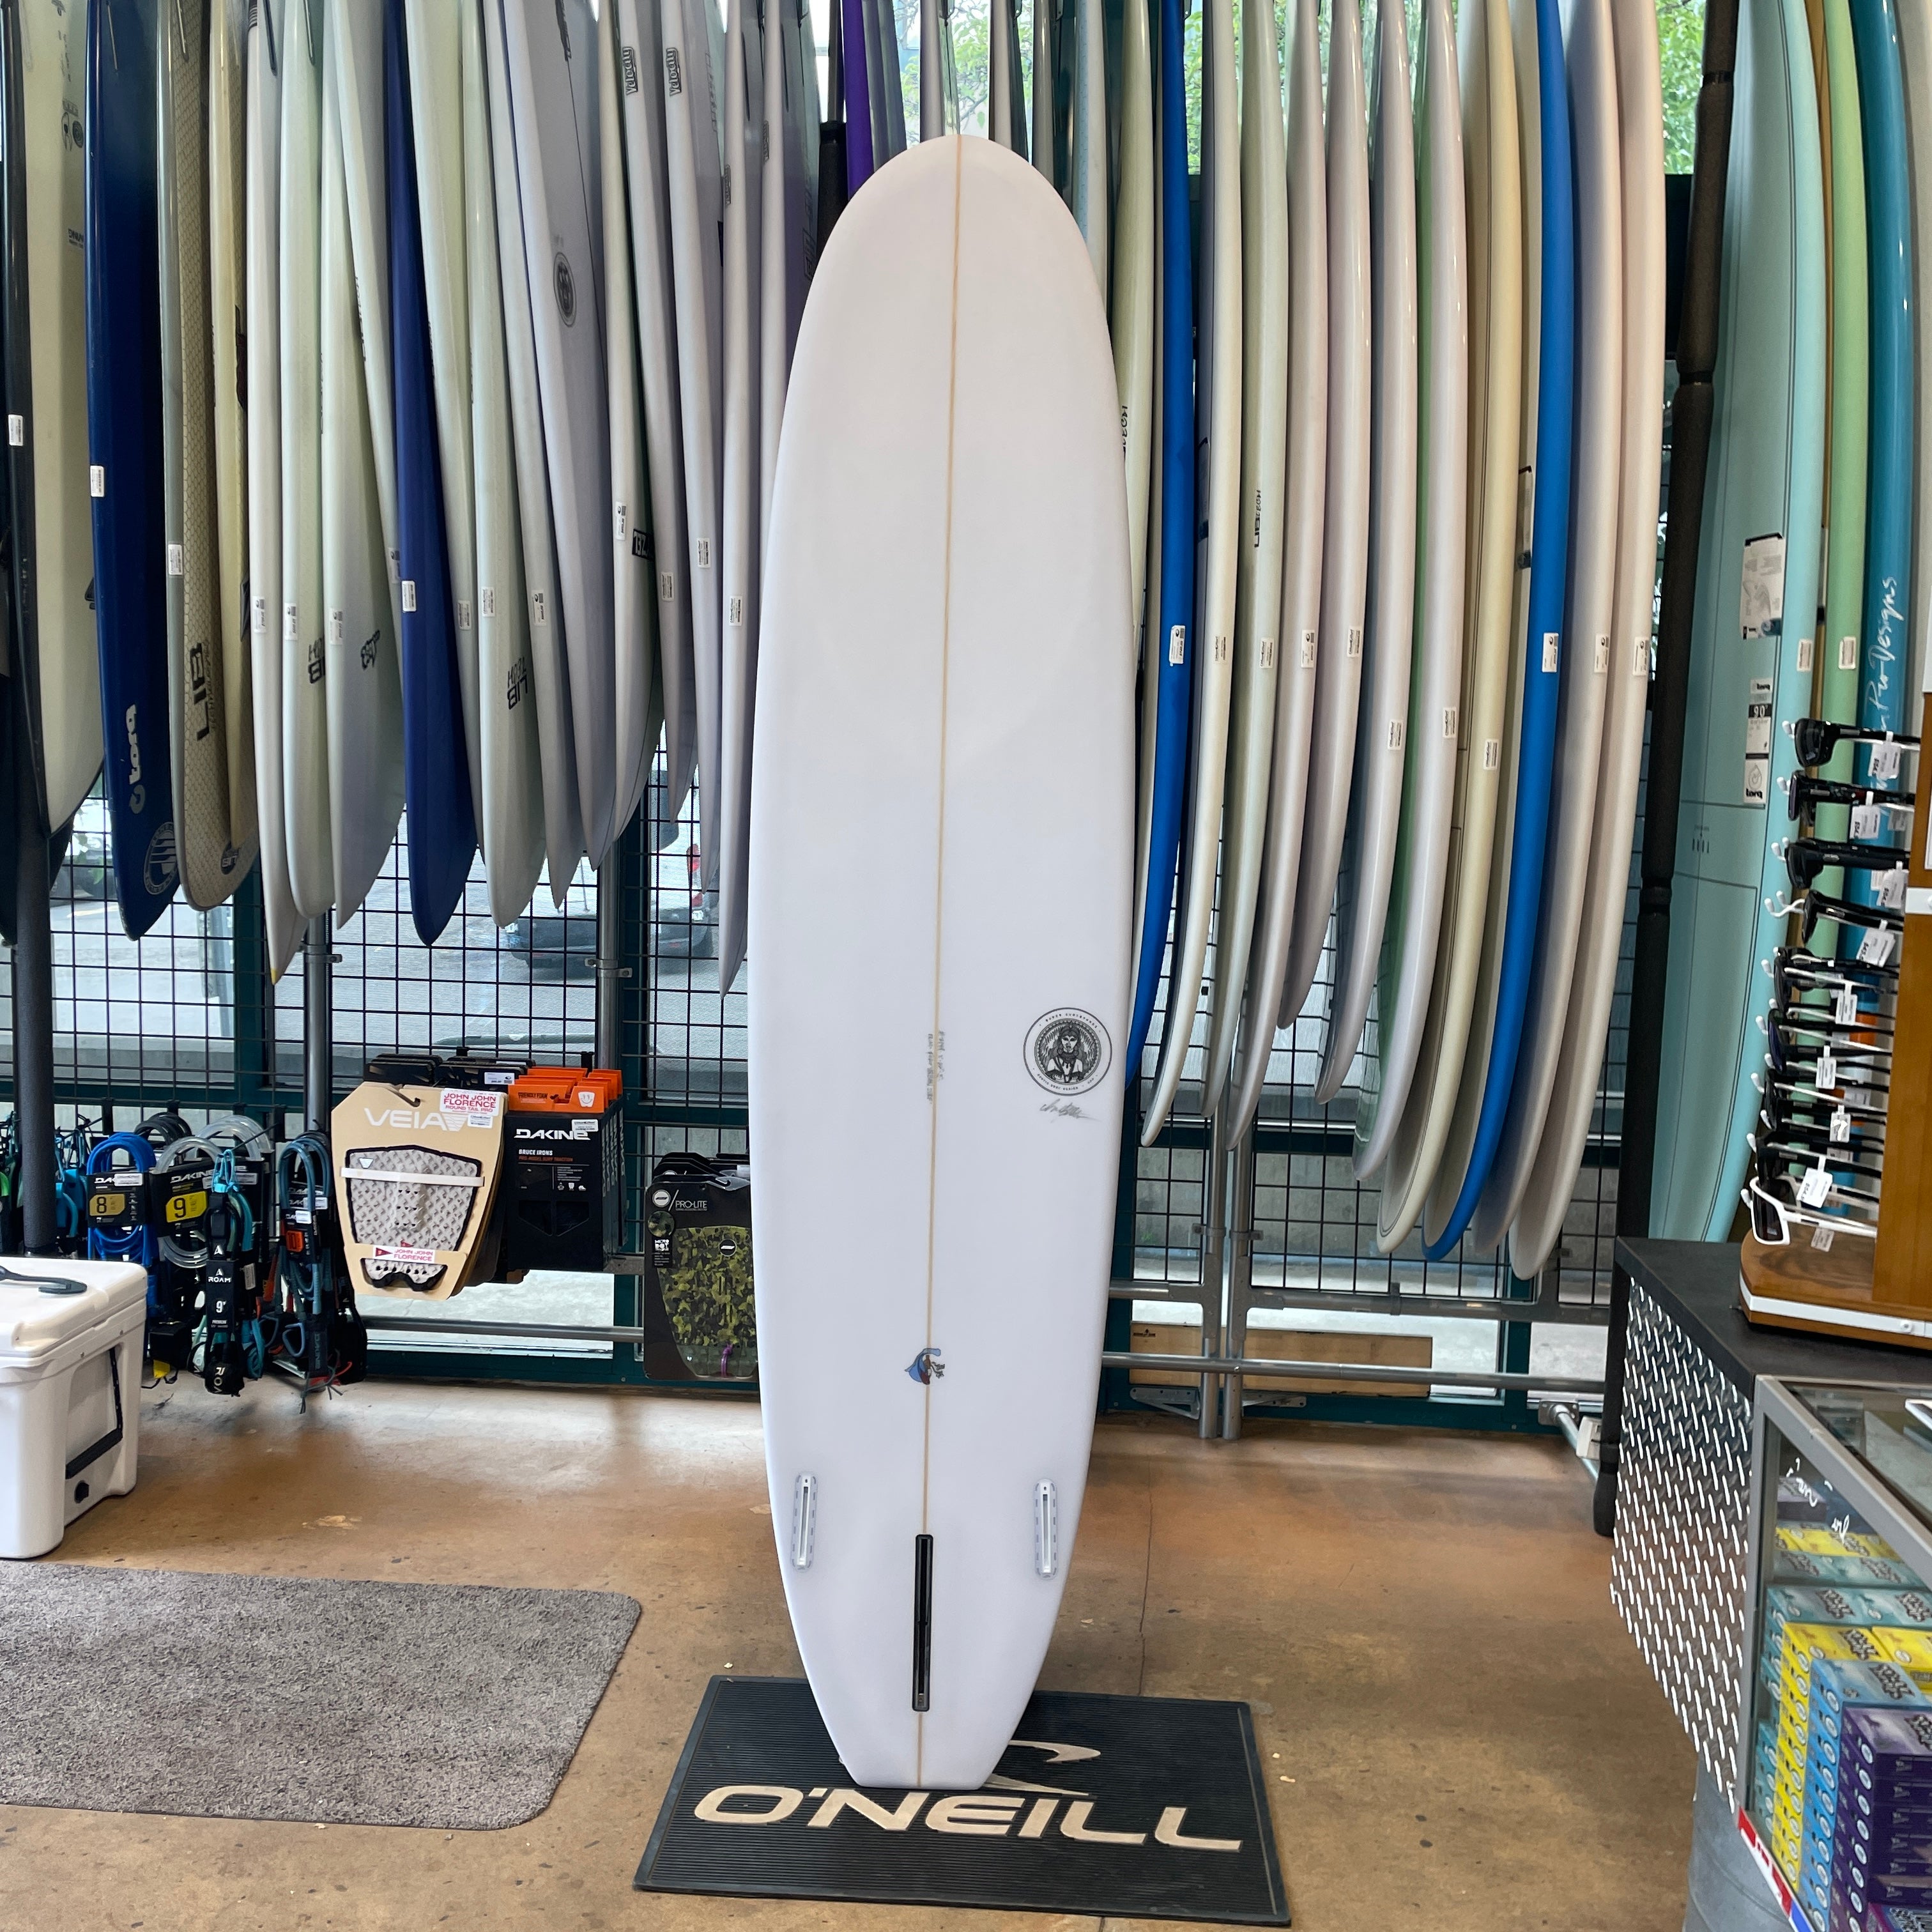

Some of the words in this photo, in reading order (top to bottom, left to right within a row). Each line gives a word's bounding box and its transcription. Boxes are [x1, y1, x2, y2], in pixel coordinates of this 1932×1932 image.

[622, 47, 638, 95] Velocity
[666, 47, 682, 96] Velocity
[190, 643, 210, 741] LIB
[125, 704, 141, 785] torq
[364, 1108, 448, 1131] VEIA
[443, 1098, 496, 1108] FLORENCE
[514, 1128, 591, 1140] DAKINE
[96, 1197, 107, 1214] 8
[173, 1198, 187, 1218] 9
[694, 1784, 1243, 1852] O'NEILL
